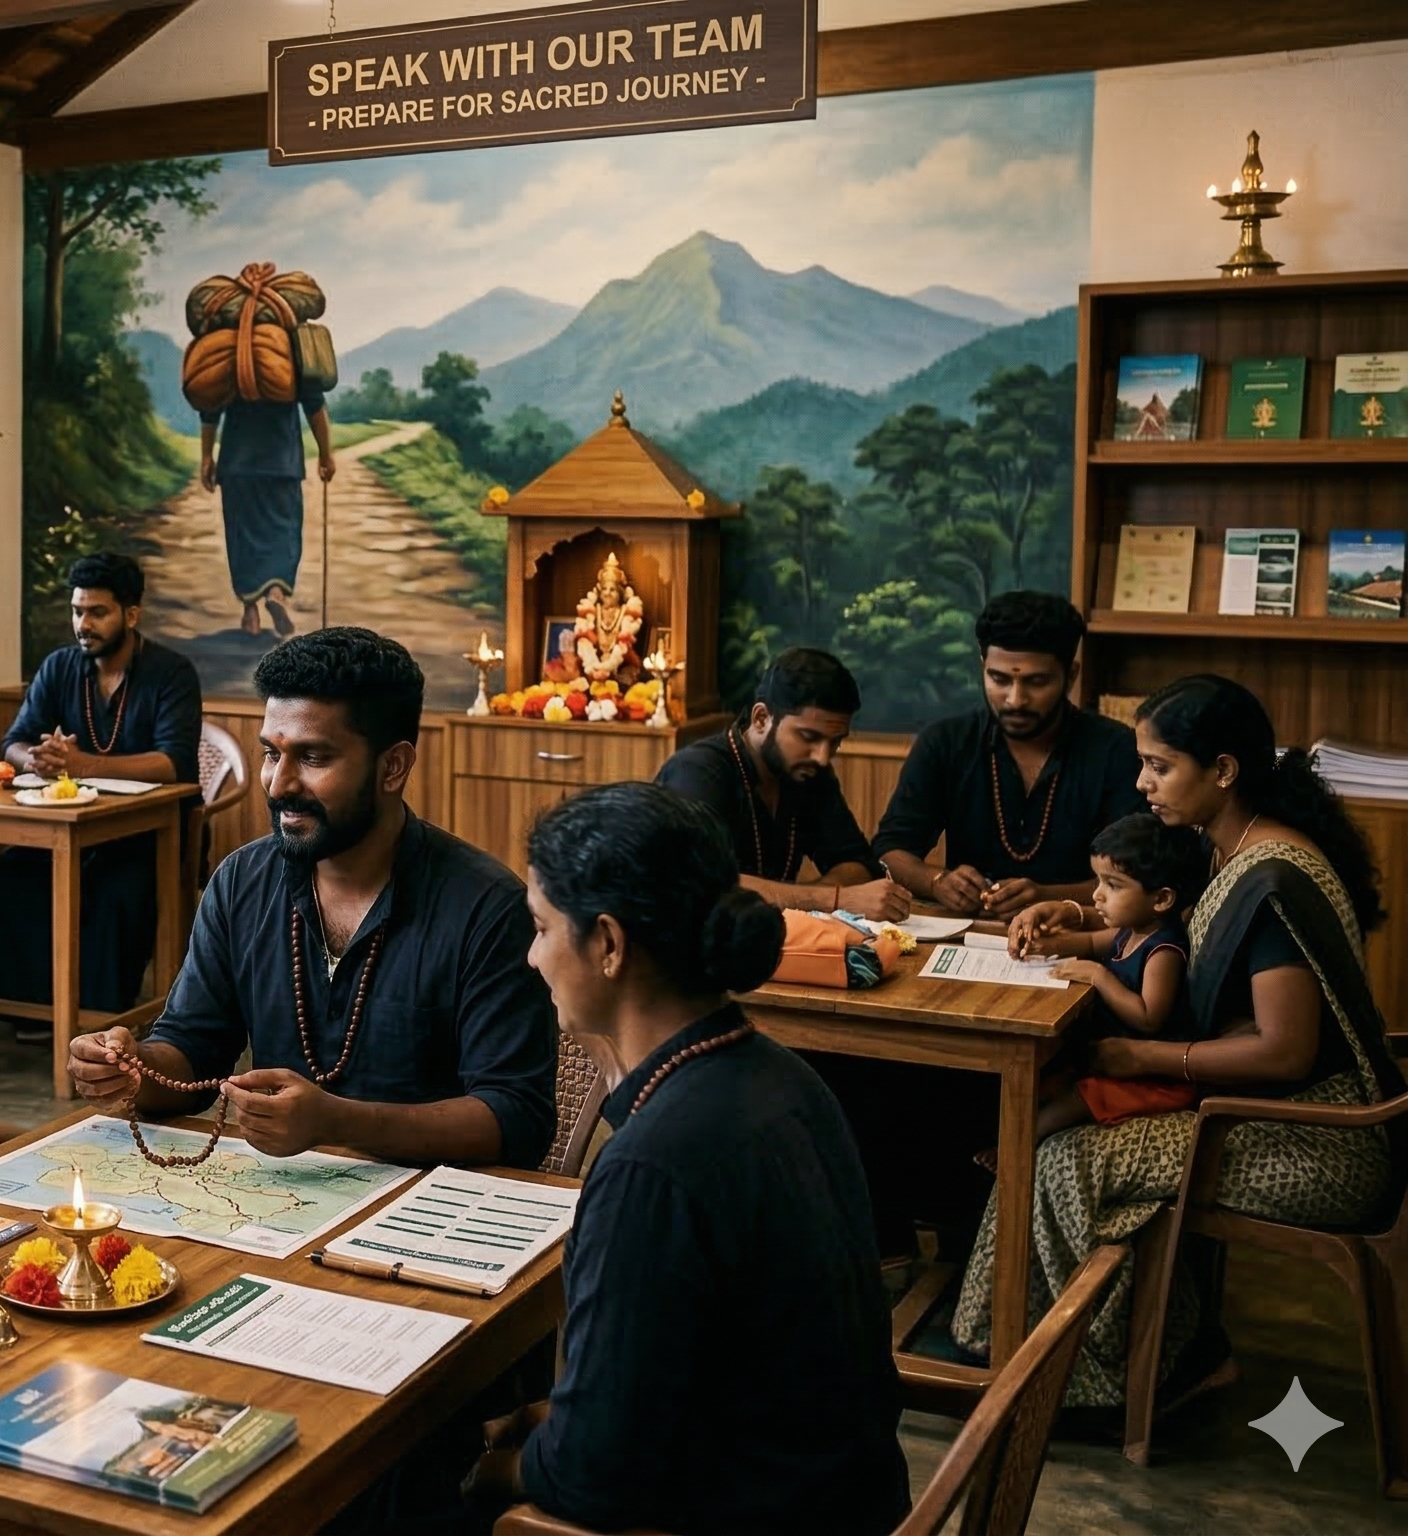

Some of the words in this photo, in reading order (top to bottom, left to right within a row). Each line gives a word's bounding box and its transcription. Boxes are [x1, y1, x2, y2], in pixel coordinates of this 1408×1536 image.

[307, 51, 430, 97] SPEAK
[439, 39, 534, 83] WITH
[547, 29, 635, 71] OUR
[646, 13, 763, 60] TEAM
[322, 98, 434, 131] PREPARE
[442, 92, 494, 120] FOR
[500, 81, 608, 114] SACRED
[616, 66, 749, 103] JOURNEY
